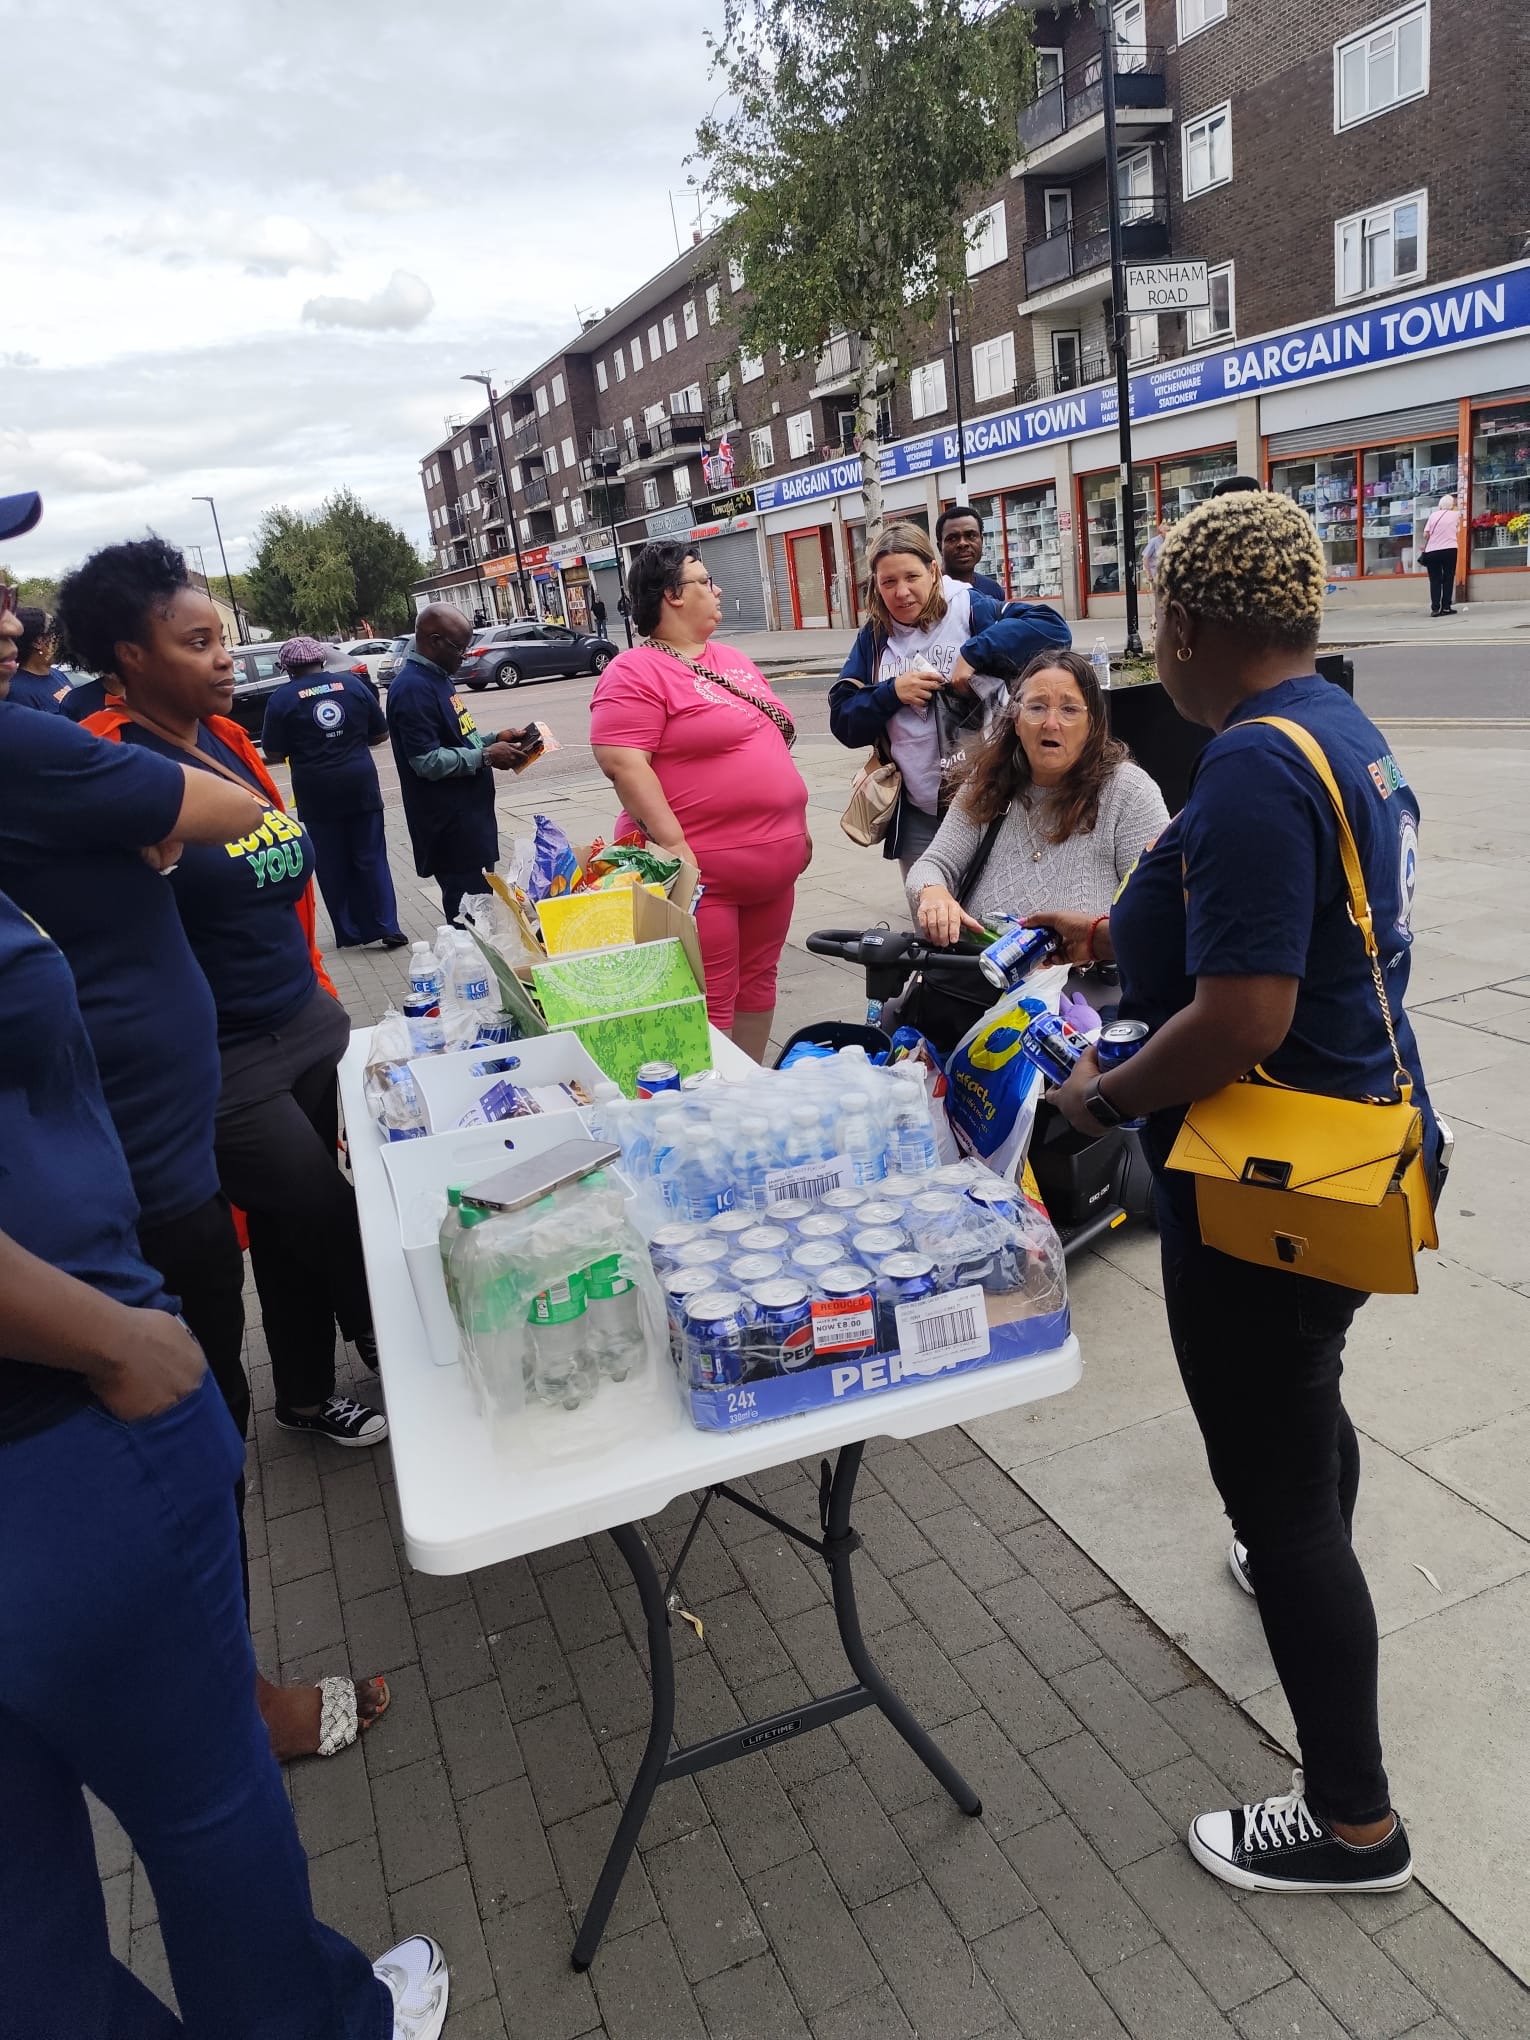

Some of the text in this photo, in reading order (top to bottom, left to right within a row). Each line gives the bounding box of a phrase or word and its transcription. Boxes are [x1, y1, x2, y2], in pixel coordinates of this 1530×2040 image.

[1129, 265, 1204, 286] FARNHAM
[1148, 287, 1188, 305] ROAD
[1223, 284, 1505, 389] BARGAIN TOWN
[1150, 362, 1205, 385] CONFECTIONERY
[1102, 382, 1133, 399] TOILES
[1154, 376, 1202, 397] KITCHENWARE
[1158, 390, 1198, 409] STATIONERY
[1024, 398, 1087, 439] TOWN
[782, 470, 830, 500] BARGAIN
[246, 840, 303, 888] YOU
[471, 981, 489, 994] ICE
[716, 1192, 735, 1210] IC
[820, 1299, 865, 1311] REDUCED
[816, 1320, 861, 1333] NOW £8.00
[728, 1390, 757, 1413] 24x
[749, 1723, 794, 1744] LIFETIME
